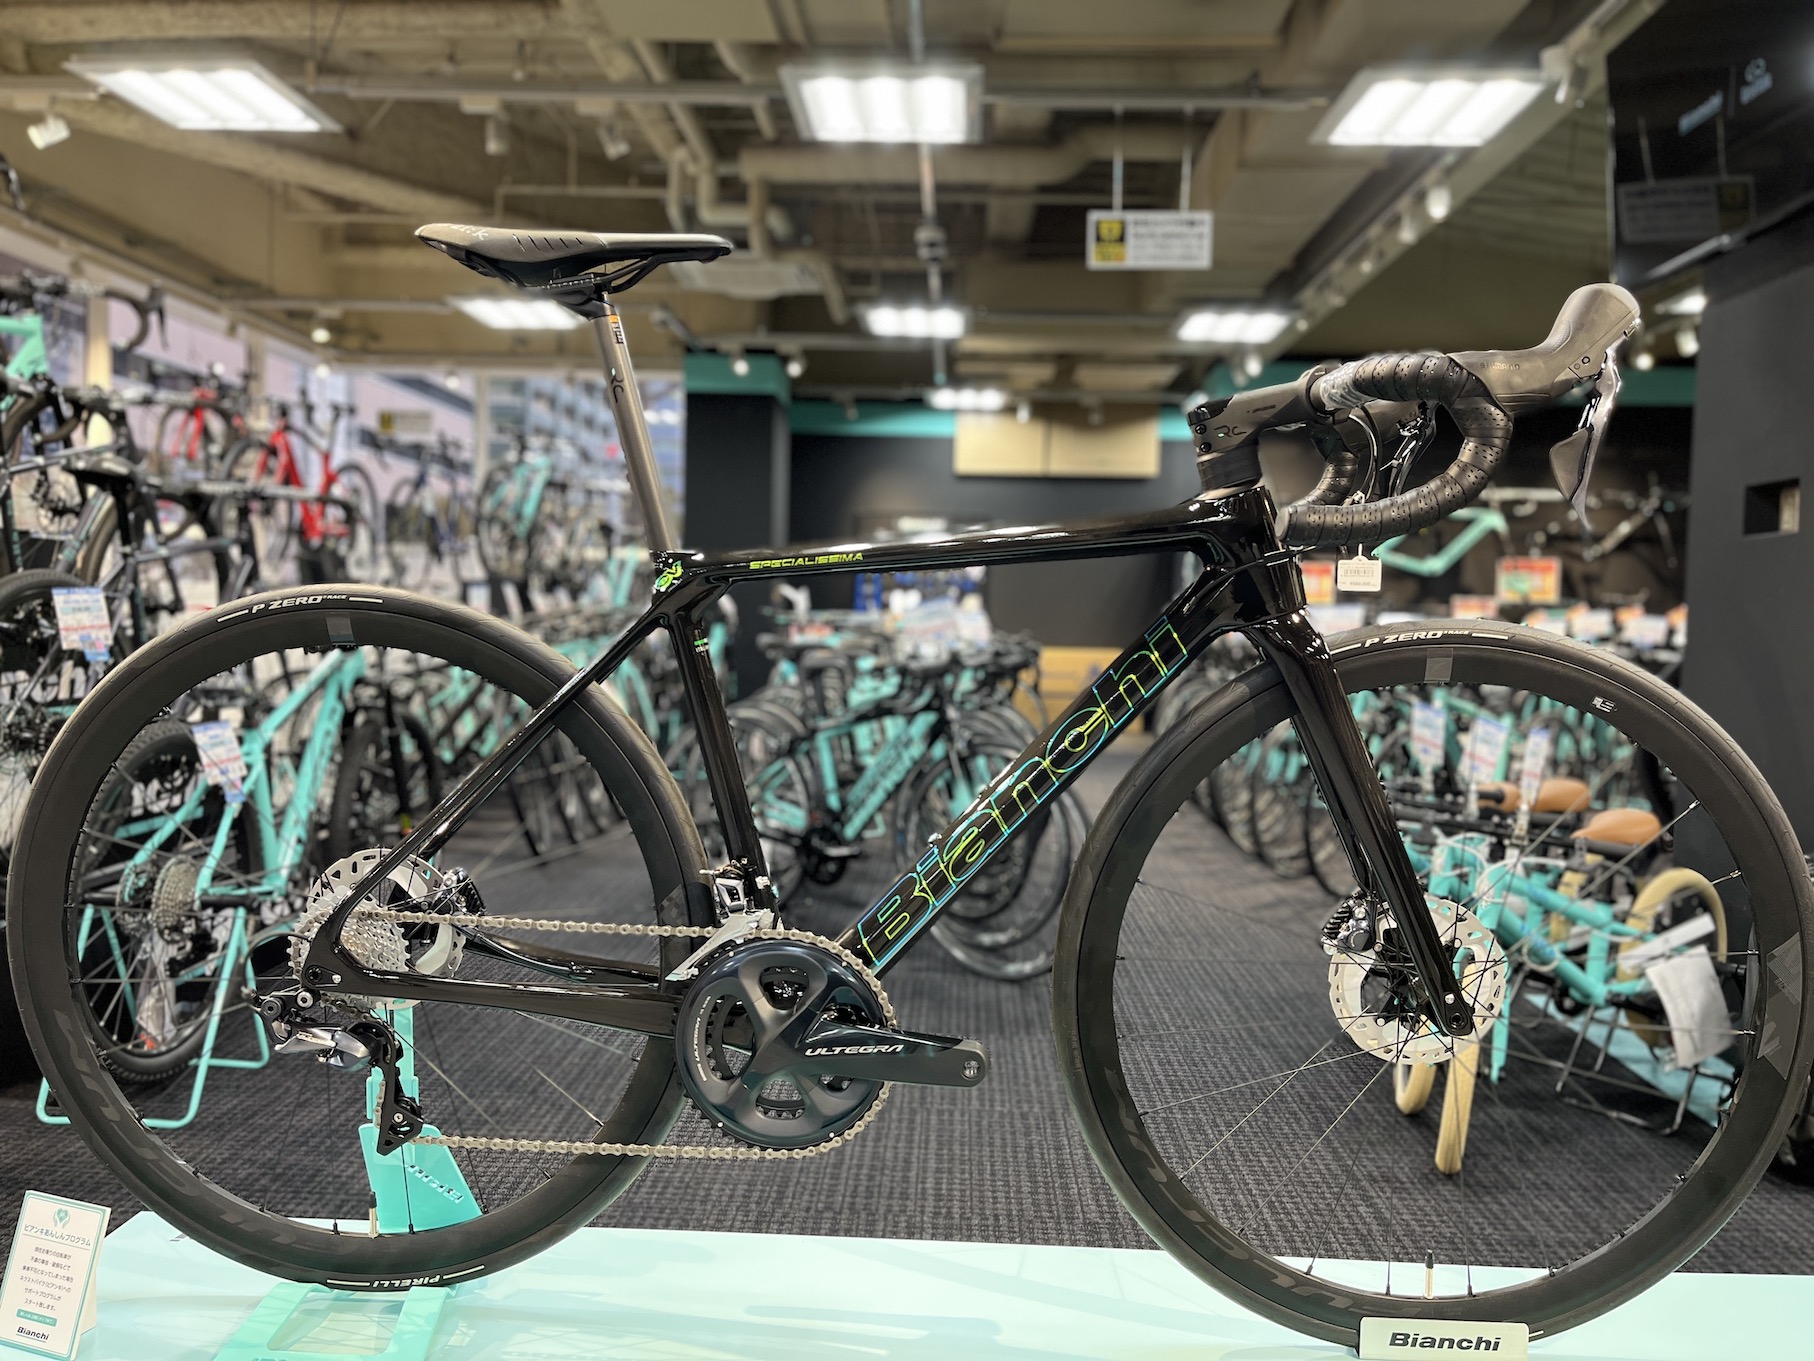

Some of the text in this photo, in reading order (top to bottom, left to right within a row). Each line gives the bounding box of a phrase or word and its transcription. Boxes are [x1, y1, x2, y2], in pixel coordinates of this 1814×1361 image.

[749, 552, 864, 570] SPECIALISSIMA
[251, 603, 266, 614] P
[268, 595, 323, 610] ZERO
[1364, 637, 1380, 648] P
[1382, 630, 1443, 645] ZERO
[857, 615, 1188, 967] Bianchi
[805, 1044, 905, 1057] ULTEGRA
[24, 1223, 92, 1247] ビアンキあんしんプログラム
[372, 1274, 441, 1288] PIRELLI
[17, 1326, 50, 1341] Bianchi
[1388, 1332, 1502, 1352] Bianchi
